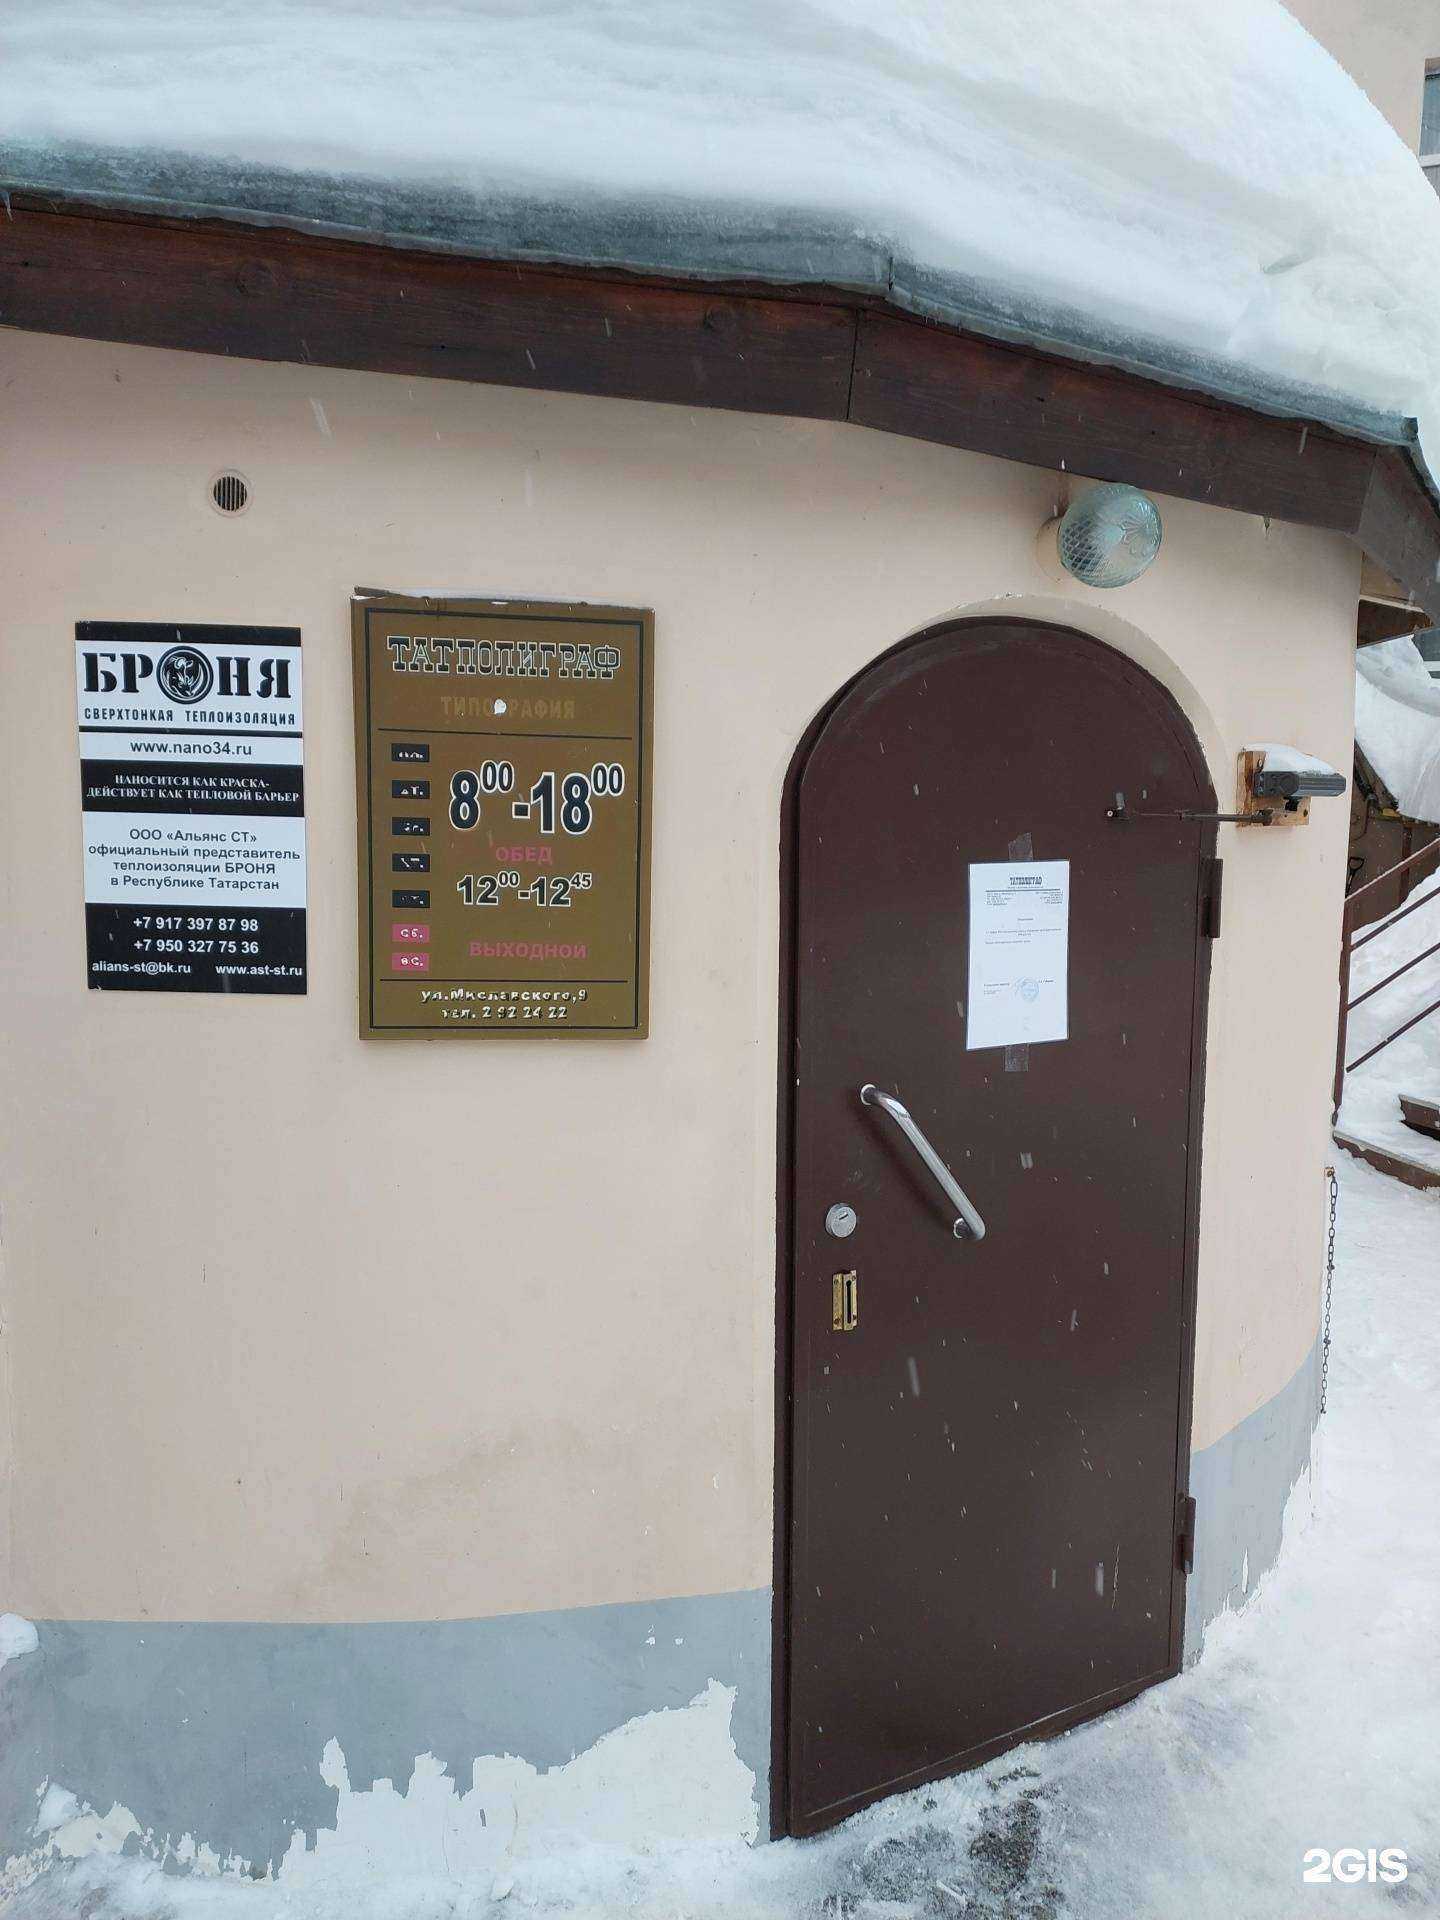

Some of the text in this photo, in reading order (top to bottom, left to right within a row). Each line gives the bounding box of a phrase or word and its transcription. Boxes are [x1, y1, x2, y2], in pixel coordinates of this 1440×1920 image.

[386, 635, 621, 680] ТАТПОЛИГРАФ
[82, 645, 292, 705] БРОНЯ
[440, 696, 575, 719] ТИПОРАФИЯ
[84, 708, 295, 726] СВЕРХТОНКАЯ ТЕПЛОИЗОЛЯЦИЯ
[130, 741, 252, 755] www.nano34.ru
[115, 775, 270, 788] НАНОСИТСЯ КАК КРАСКА-
[86, 787, 300, 802] ДЕЙСТВУЕТ КАК ТЕПЛОВОЙ БАРЬЕР
[129, 829, 257, 843] ООО «Альянс СТ»
[88, 845, 300, 860] официальный представитель
[496, 846, 553, 866] ОБЕД
[113, 861, 276, 875] теплоизоляции БРОНЯ
[110, 875, 280, 891] в Республике Татарстан
[133, 917, 259, 932] +7 917 397 87 98
[134, 939, 259, 954] +7 950 327 75 36
[469, 941, 587, 961] ВЫХОДНОЙ
[92, 961, 303, 976] alians-st@bk.ru www.ast-st.ru
[482, 1006, 492, 1018] 2
[523, 1006, 542, 1018] 24
[548, 1006, 568, 1019] 22
